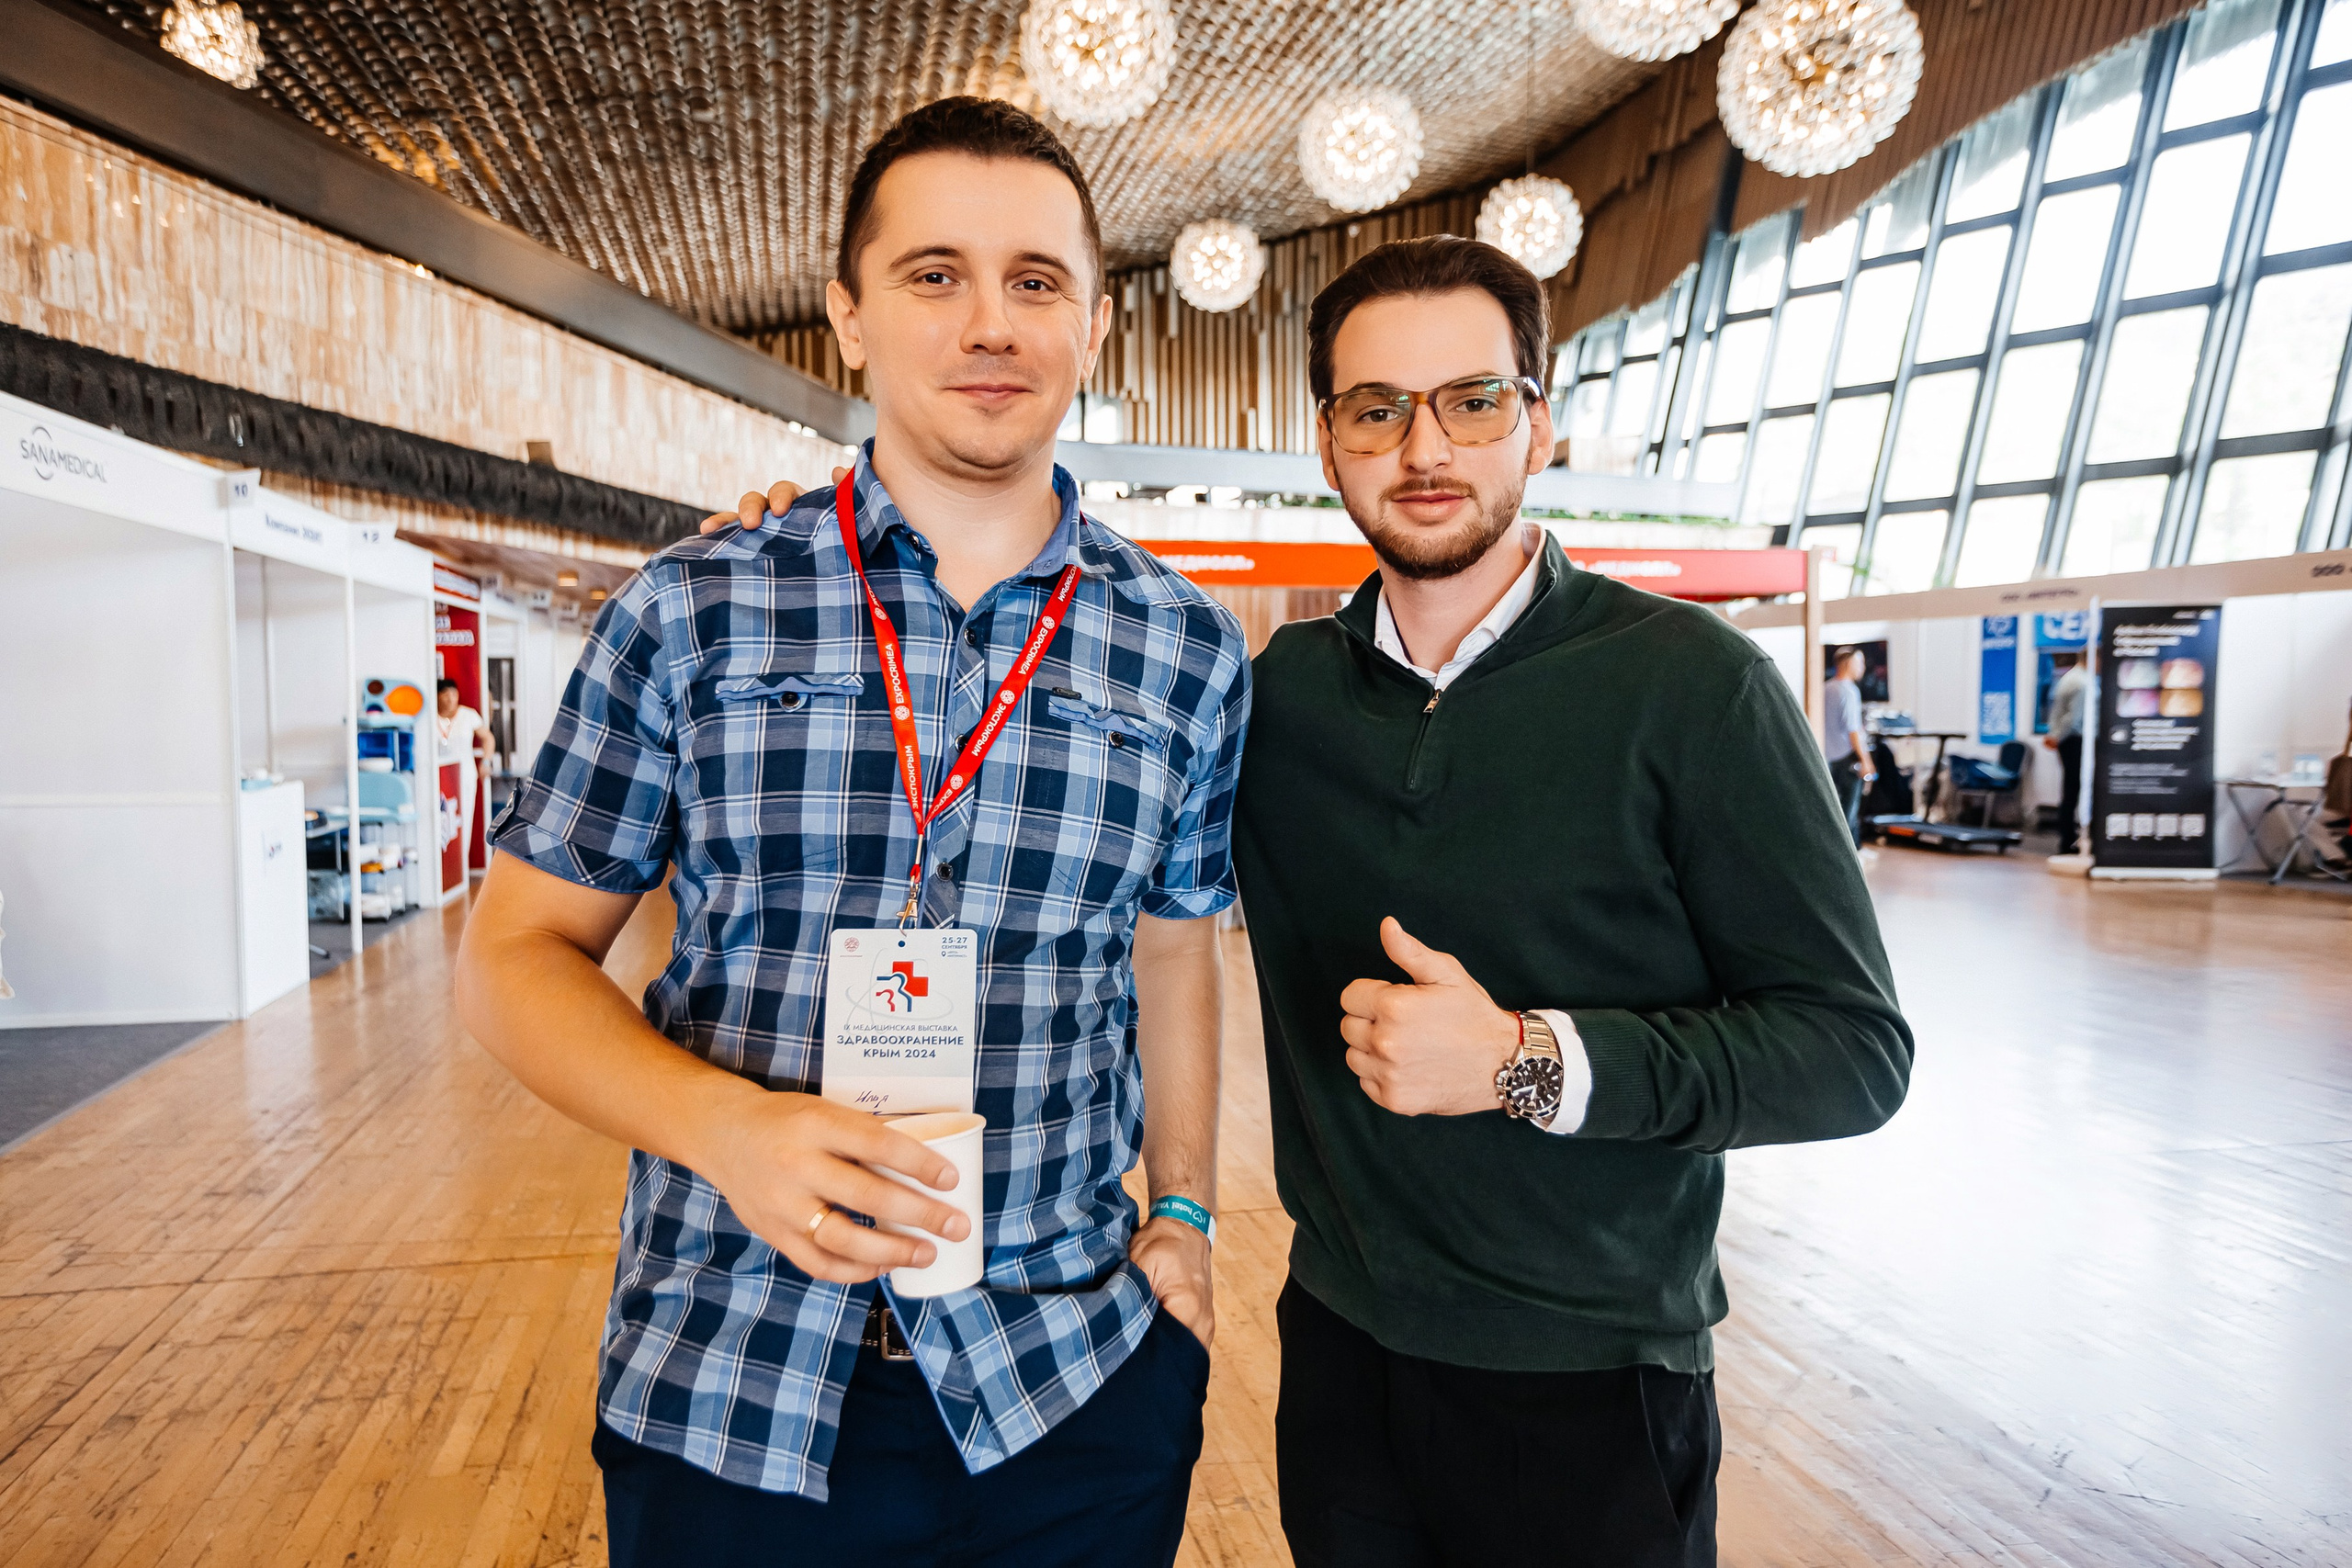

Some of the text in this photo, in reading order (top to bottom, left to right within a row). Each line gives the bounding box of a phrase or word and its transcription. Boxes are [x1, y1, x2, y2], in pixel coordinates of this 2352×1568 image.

[20, 439, 107, 482] SANAMEDICAL
[234, 484, 248, 497] 10
[362, 532, 379, 543] 12
[1017, 626, 1049, 675] EXPOCRIMEA
[885, 643, 905, 705] EXPOCRIMEA
[971, 702, 1007, 757] ЭКСПОКРЫМ
[904, 744, 919, 809] ЭКСПОКРЫМ
[942, 936, 967, 944] 25-27
[837, 1034, 964, 1045] ЗДРАВООХРАНЕНИЕ
[864, 1048, 936, 1058] КРЫМ 2024
[854, 1090, 889, 1109] Илья
[1171, 1201, 1193, 1215] hotel
